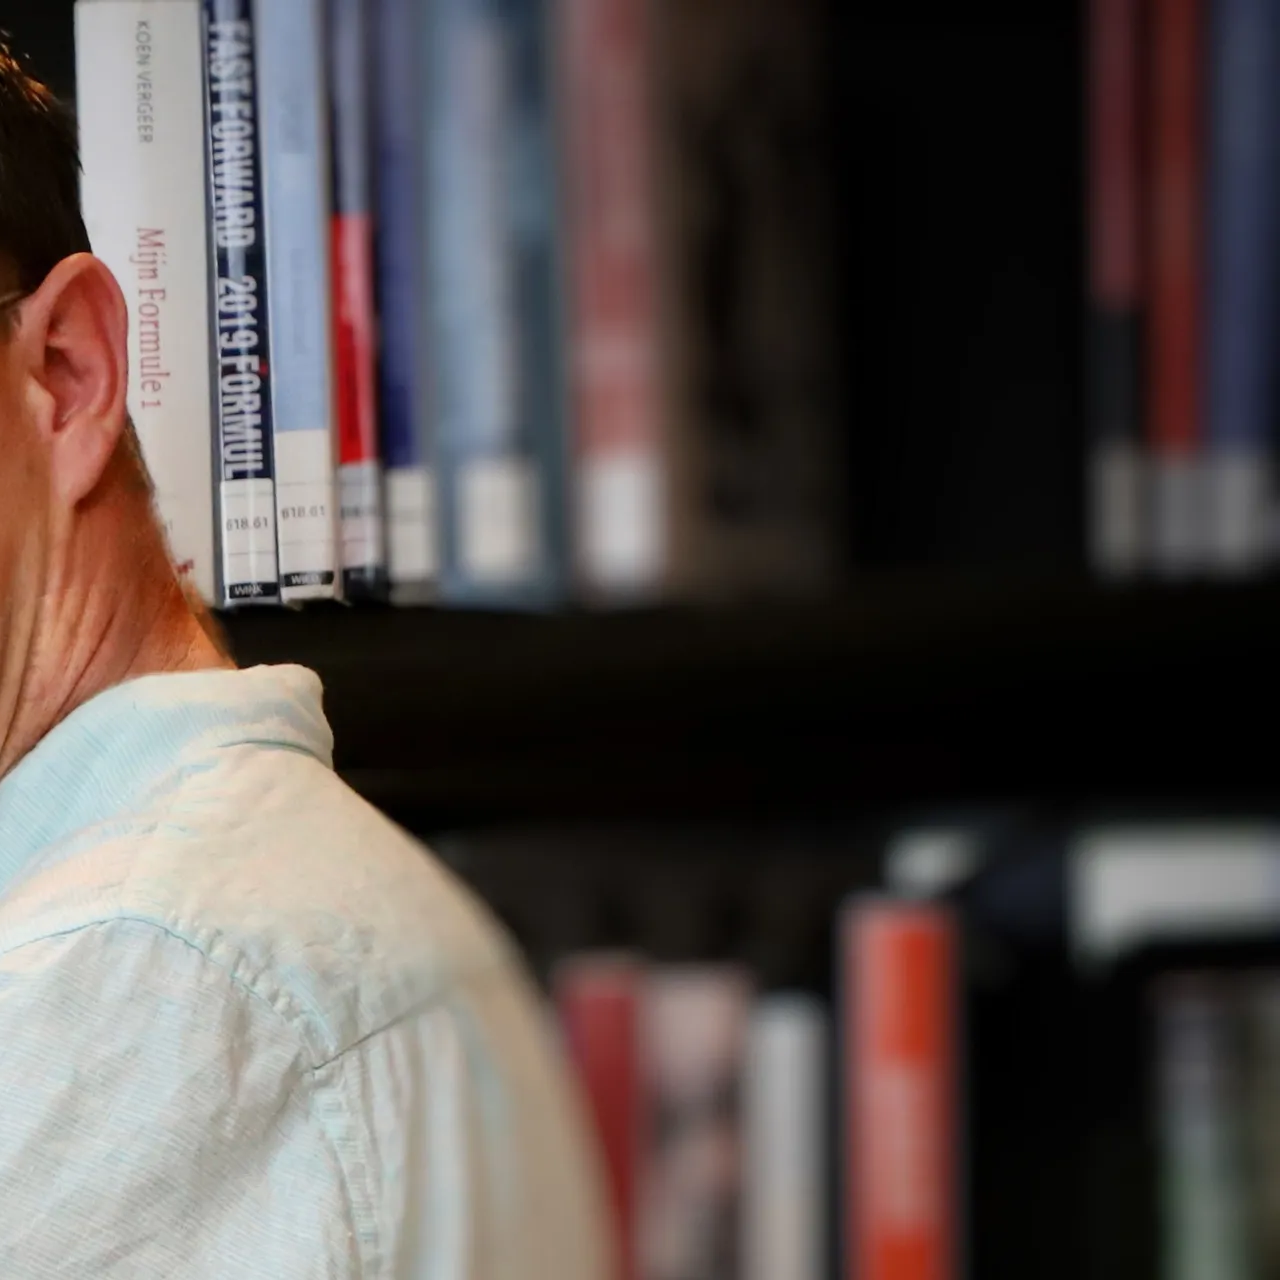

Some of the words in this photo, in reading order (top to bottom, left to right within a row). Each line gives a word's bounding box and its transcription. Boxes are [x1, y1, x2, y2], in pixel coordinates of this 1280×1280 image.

[134, 20, 151, 66] KOEN
[208, 19, 251, 93] FAST
[136, 72, 154, 144] VERGEER
[211, 101, 256, 248] FORWARD
[129, 228, 168, 281] Mijn
[138, 288, 171, 394] Formule
[217, 275, 260, 350] 2019
